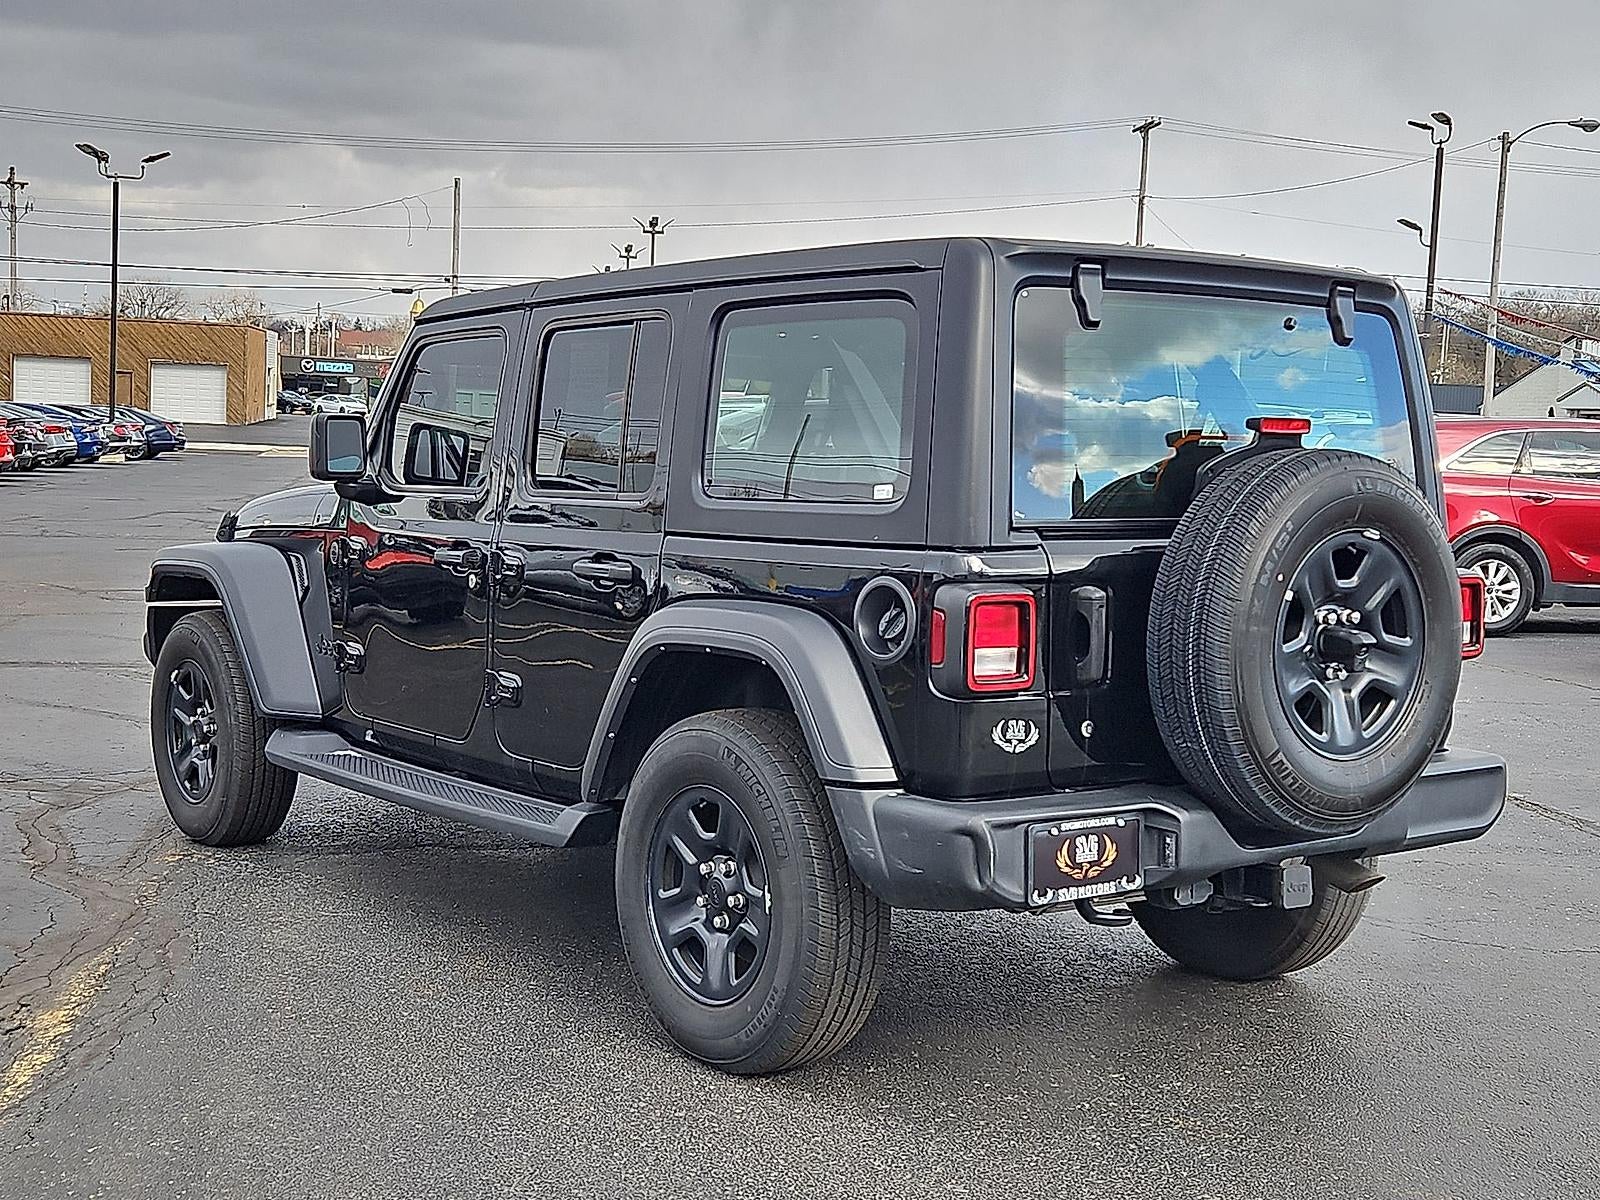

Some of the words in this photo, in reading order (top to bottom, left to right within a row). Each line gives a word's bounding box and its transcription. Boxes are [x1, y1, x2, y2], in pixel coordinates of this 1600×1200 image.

[316, 361, 354, 373] mazda
[1007, 719, 1026, 733] SVG
[737, 760, 789, 859] MICHELIN
[1075, 834, 1099, 854] SVG
